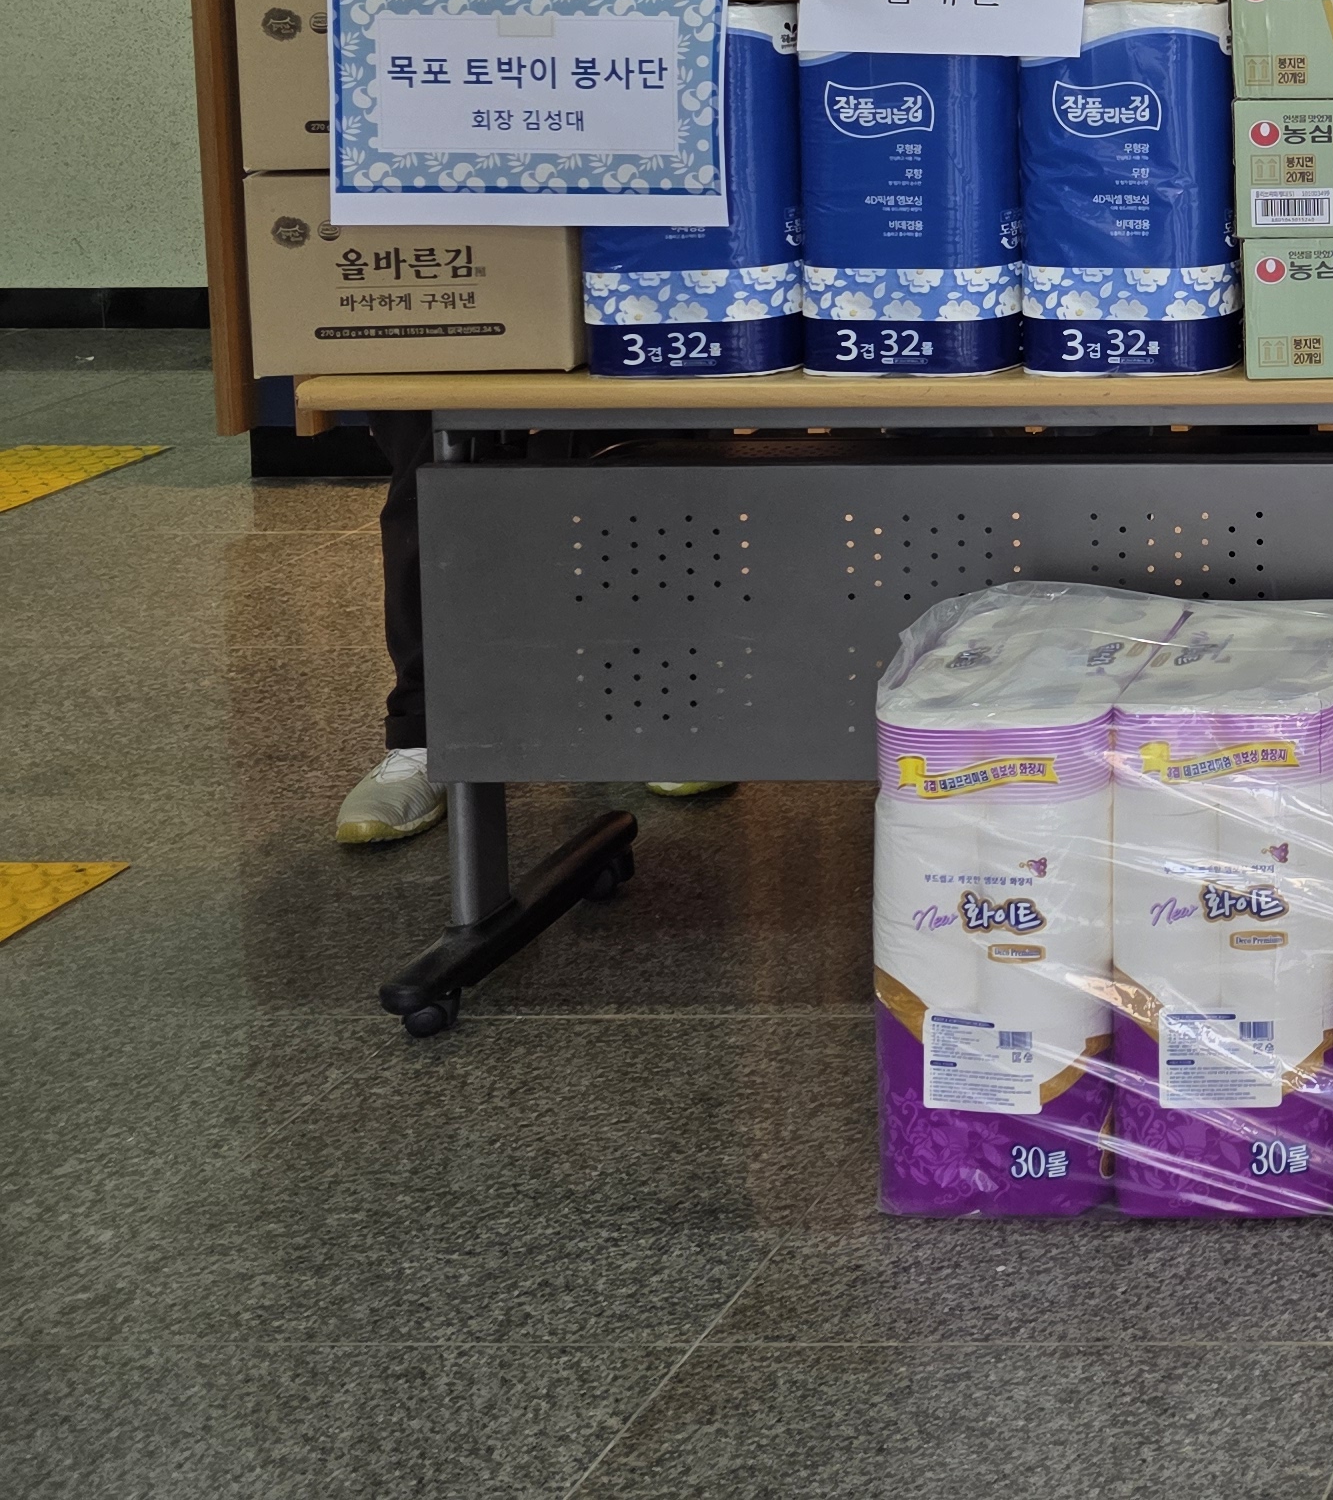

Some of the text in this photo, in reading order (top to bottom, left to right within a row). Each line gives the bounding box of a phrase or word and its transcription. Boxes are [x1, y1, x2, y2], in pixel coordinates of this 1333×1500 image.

[386, 55, 669, 90] 목포 토박이 봉사단
[471, 109, 585, 132] 회장 김성대
[832, 94, 924, 127] 잘풀리는집
[1060, 94, 1151, 127] 잘풀리는집
[1282, 124, 1333, 145] 농심
[335, 245, 475, 281] 올바른김
[339, 290, 477, 312] 바삭하게 구워낸
[621, 332, 664, 366] 3겹
[835, 328, 876, 362] 3겹
[1061, 328, 1101, 362] 3겹
[963, 890, 1045, 933] 화이트
[1009, 1144, 1069, 1180] 30롤
